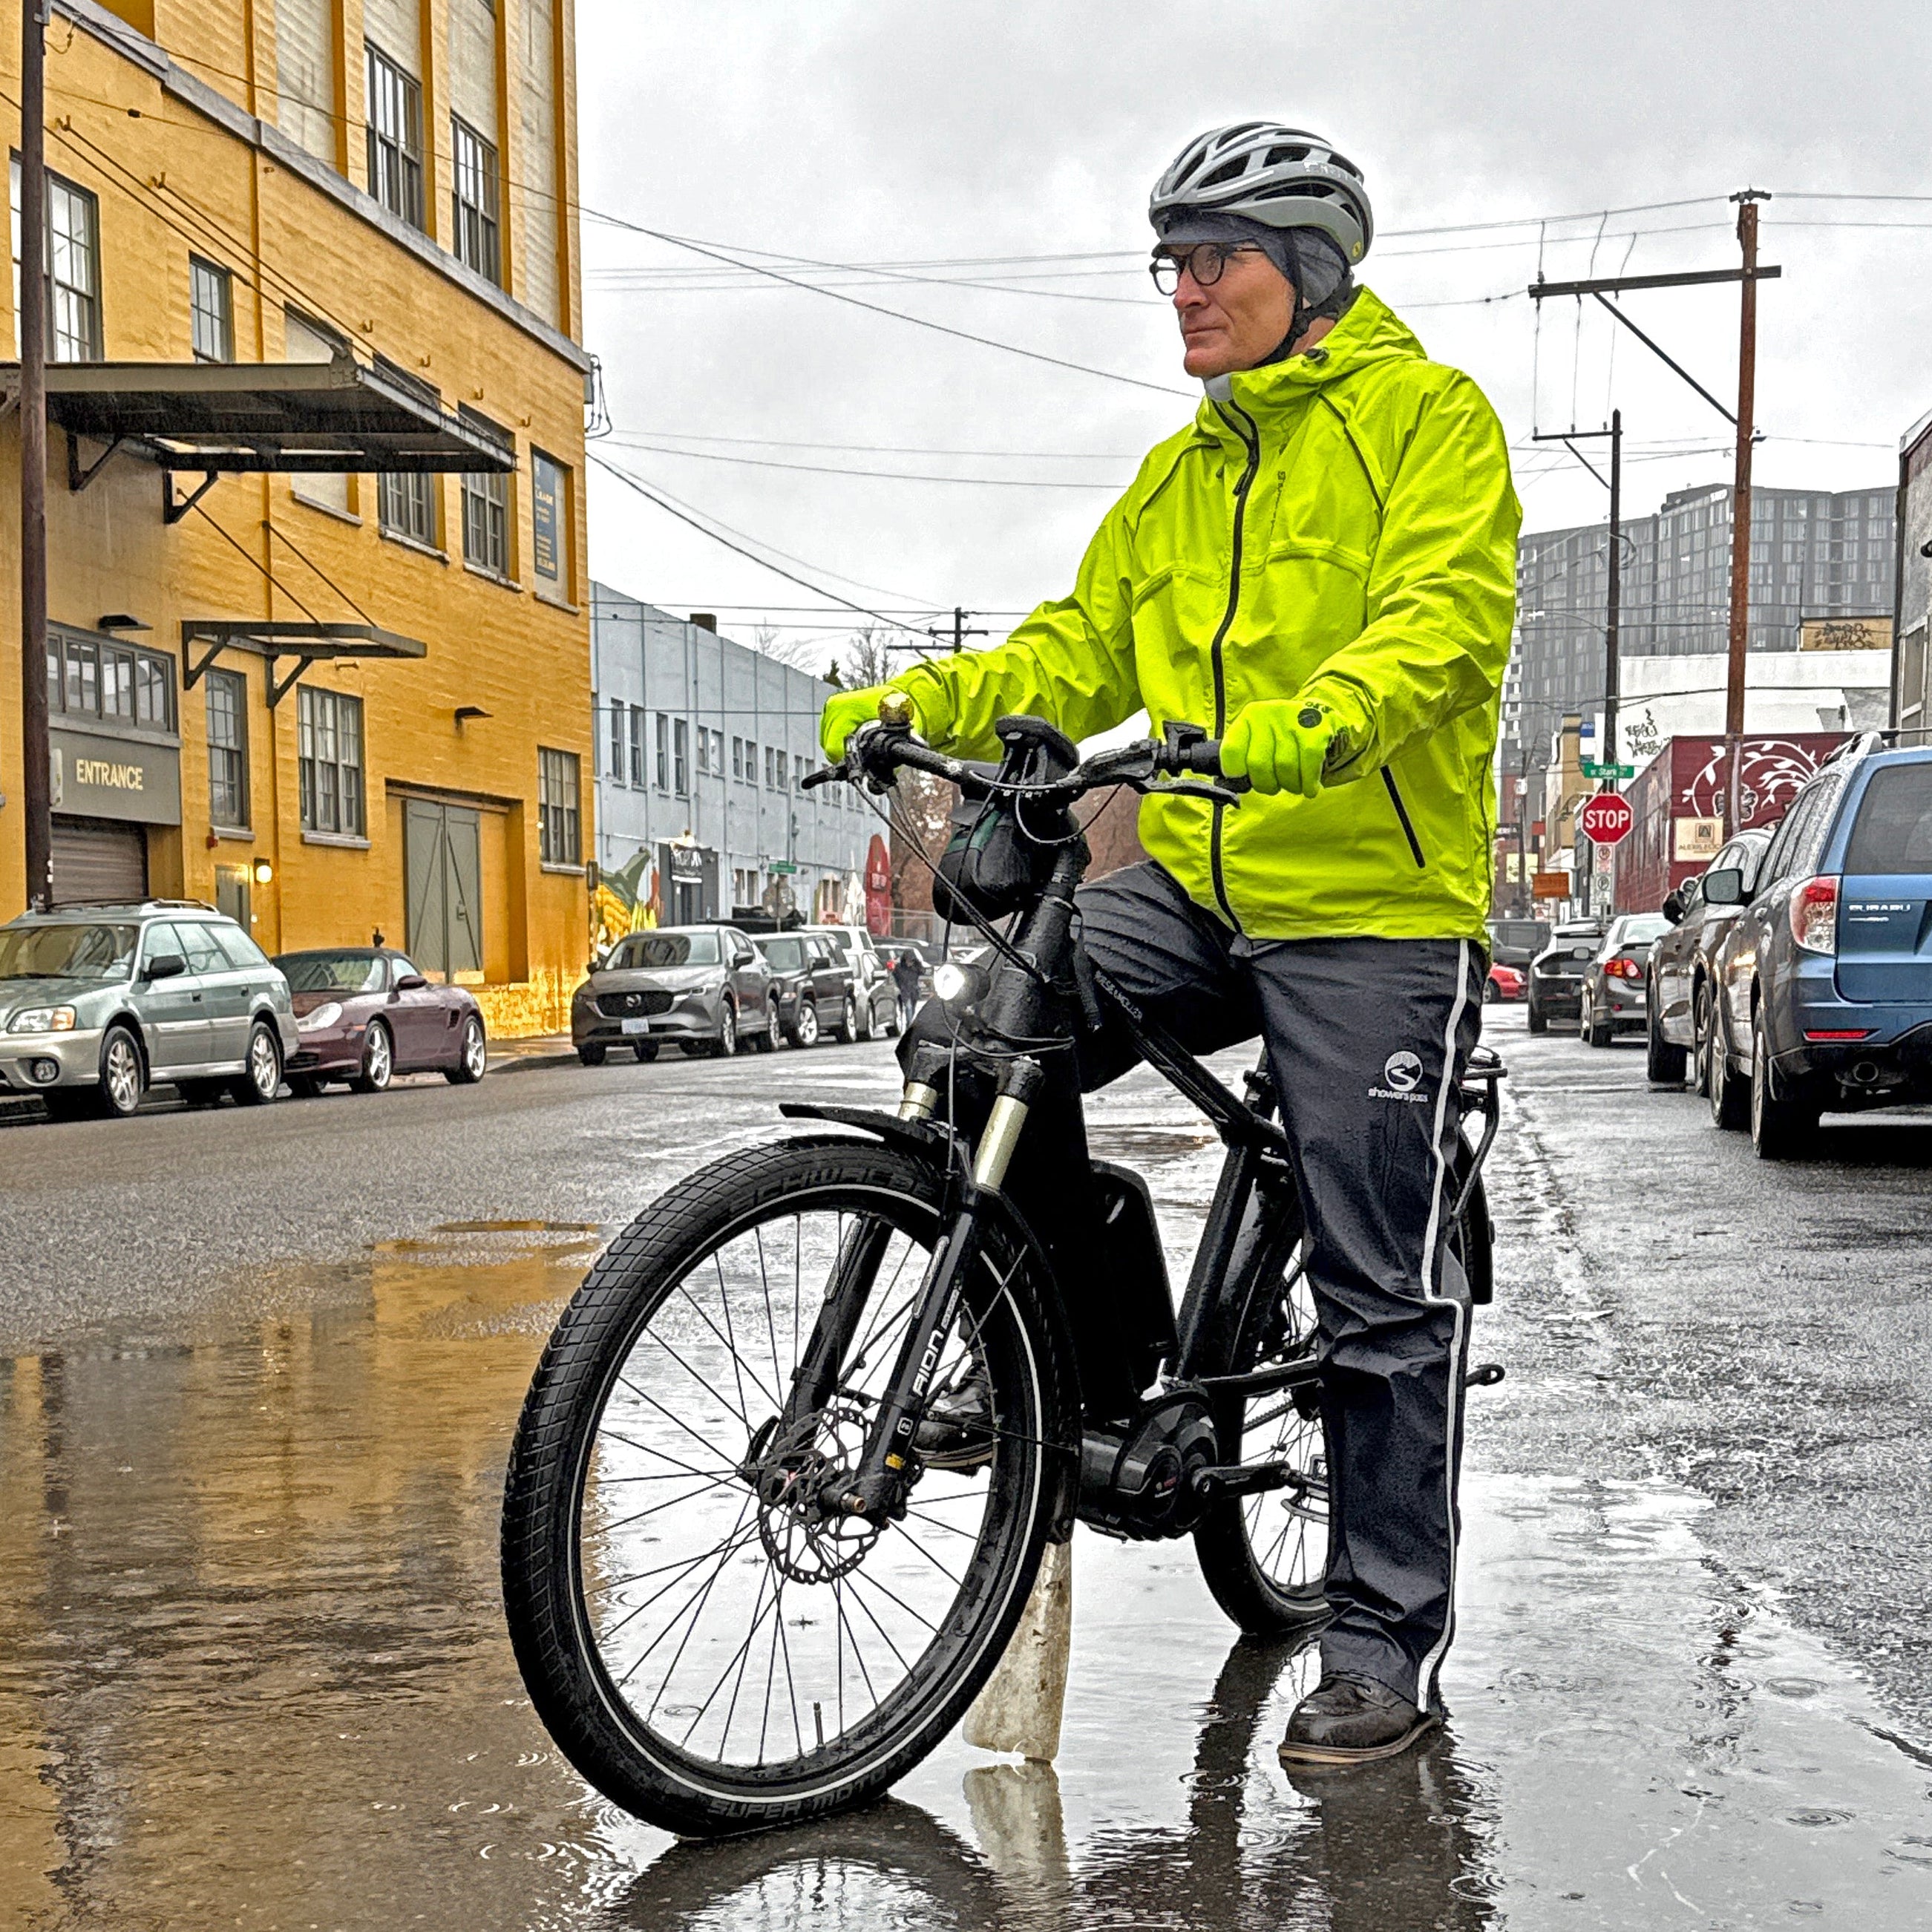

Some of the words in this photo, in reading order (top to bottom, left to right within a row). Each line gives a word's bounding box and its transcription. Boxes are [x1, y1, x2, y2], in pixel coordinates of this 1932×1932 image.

[76, 759, 143, 790] ENTRANCE
[1585, 809, 1630, 829] STOP
[1848, 904, 1911, 912] SUBARU
[912, 1329, 944, 1397] AION
[707, 1798, 802, 1820] SUPER
